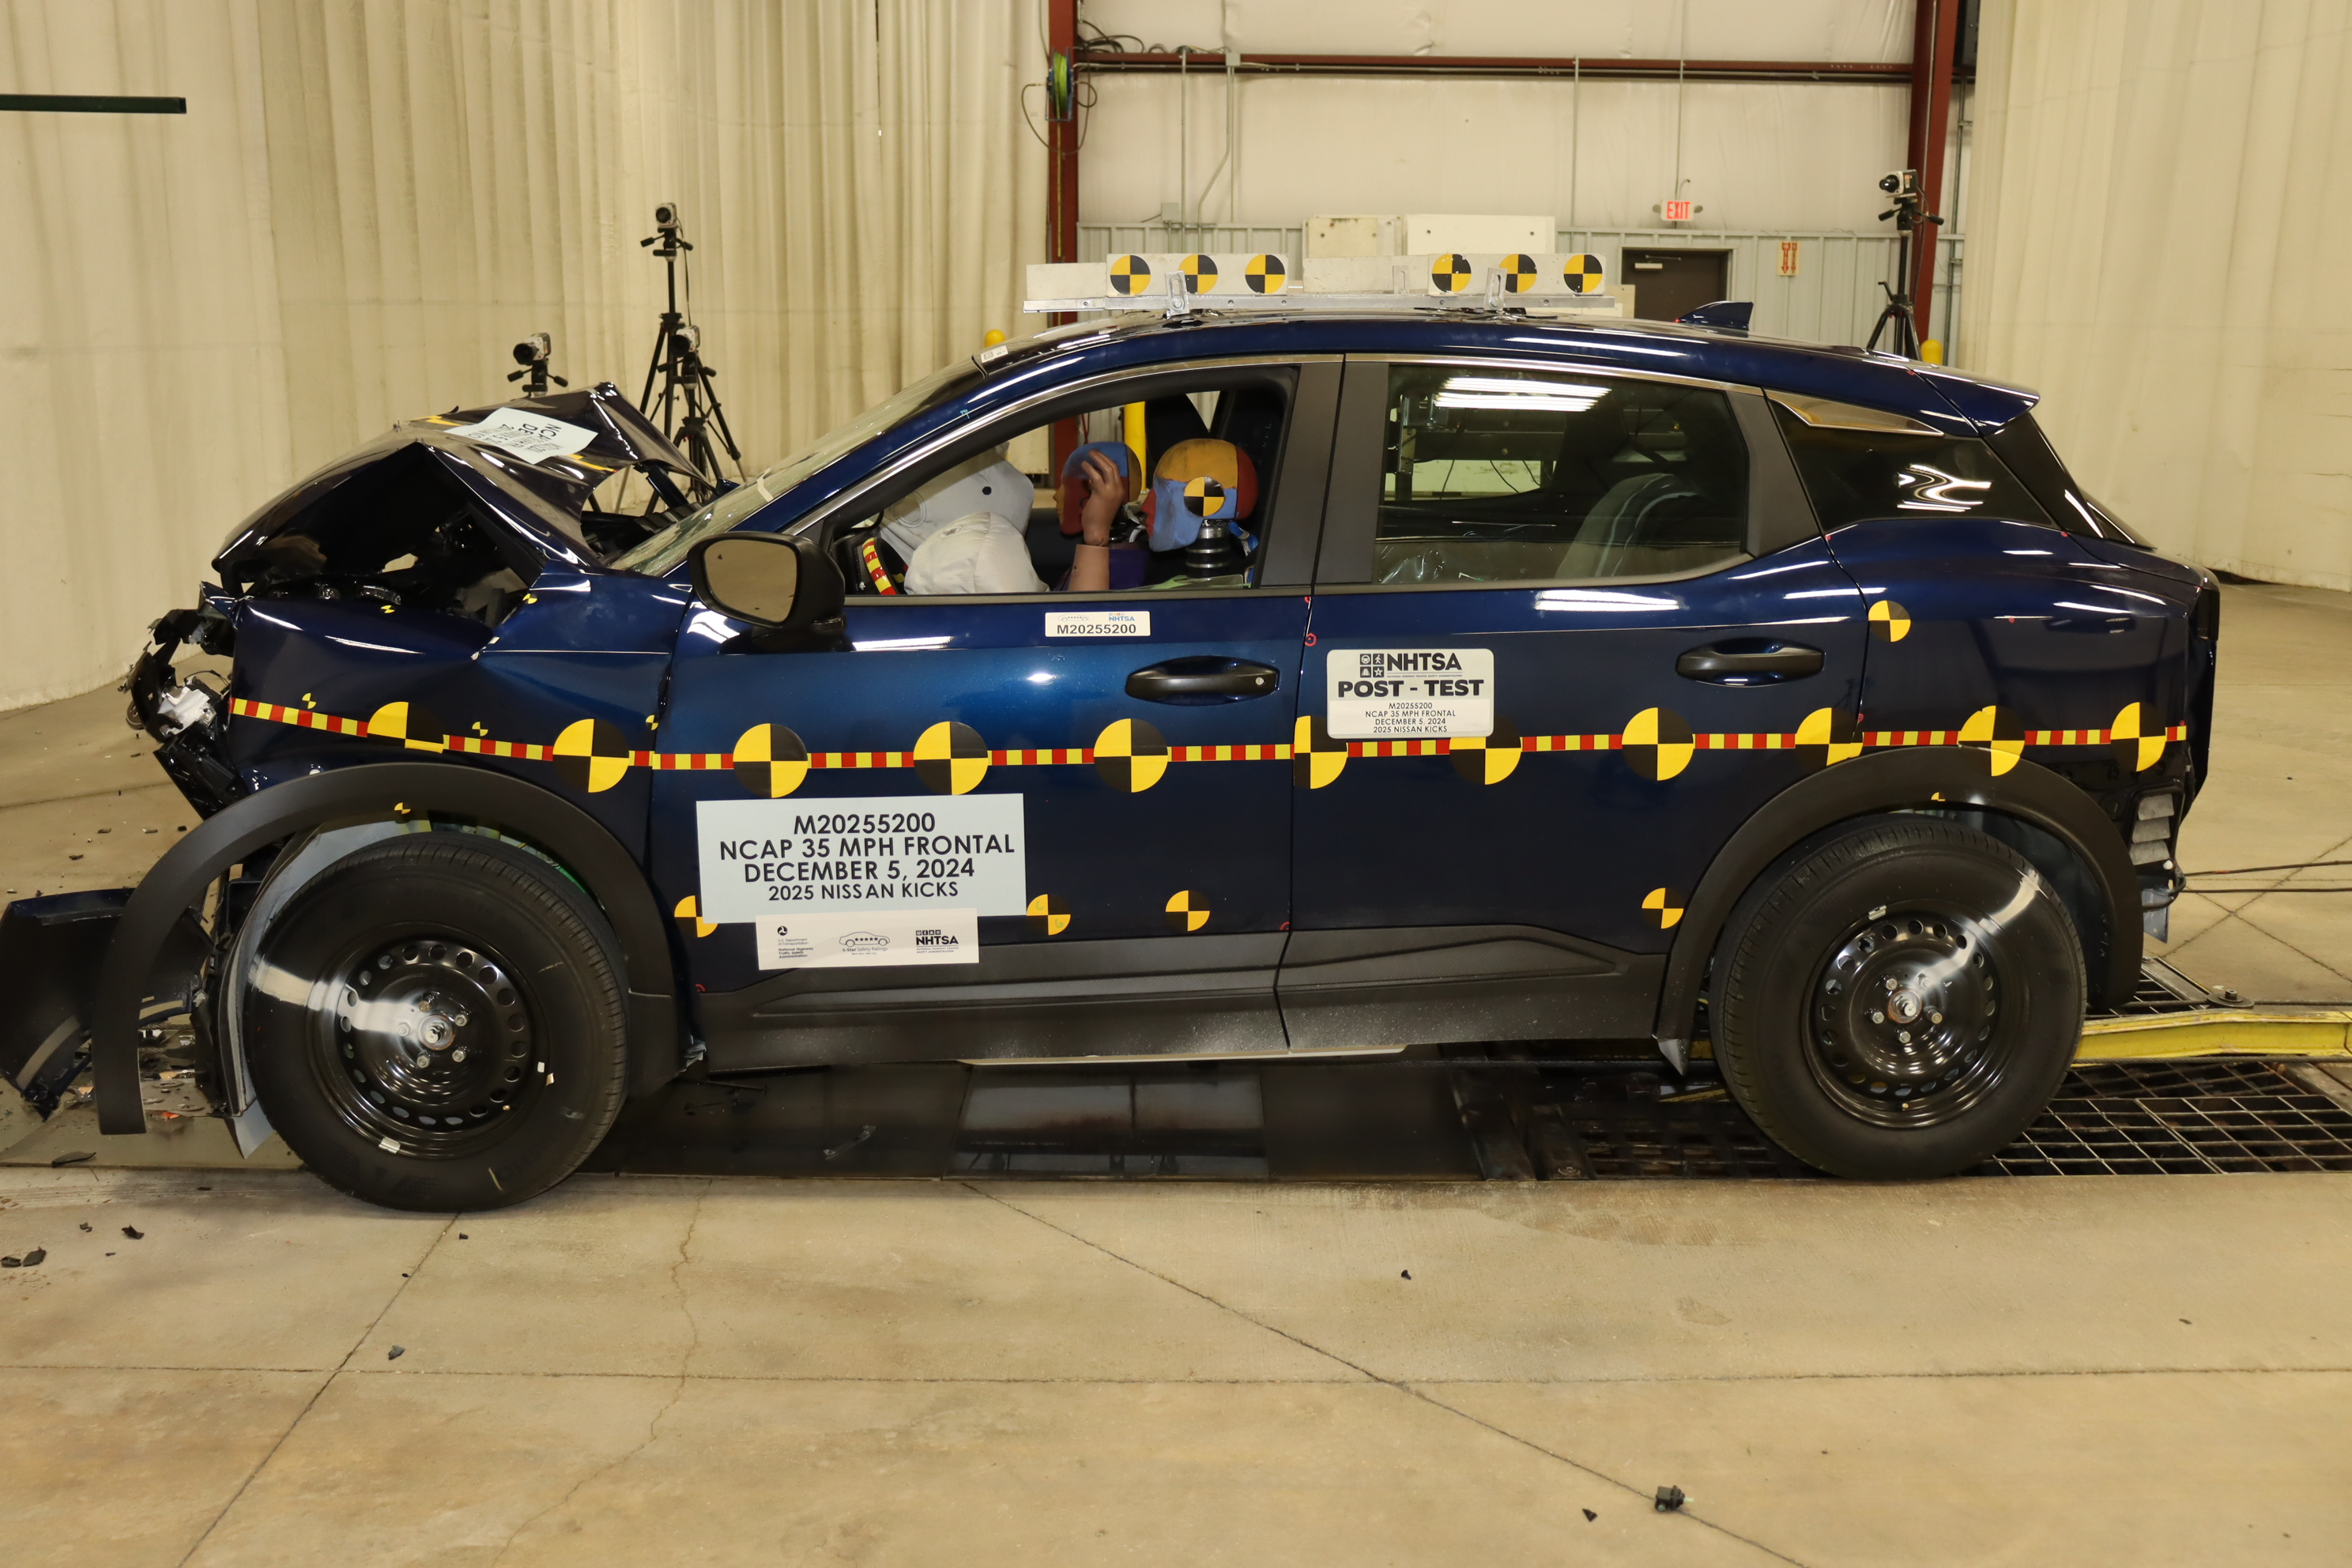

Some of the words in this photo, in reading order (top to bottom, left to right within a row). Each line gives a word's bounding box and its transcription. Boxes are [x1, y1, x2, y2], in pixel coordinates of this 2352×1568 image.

[1667, 201, 1690, 220] EXIT
[1057, 624, 1136, 634] M20255200
[1387, 652, 1462, 671] NHTSA
[1338, 680, 1404, 698] POST
[1424, 679, 1484, 697] TEST
[793, 812, 936, 835] M20255200
[720, 839, 793, 860] NCAP
[801, 838, 831, 858] 35
[839, 836, 895, 857] MPH
[904, 834, 1015, 855] FRONTAL
[744, 859, 879, 883] DECEMBER
[887, 860, 908, 882] 5,
[916, 858, 974, 879] 2024
[768, 884, 814, 901] 2025
[821, 883, 895, 900] NISSAN
[902, 881, 959, 898] KICKS
[916, 935, 959, 945] NHTSA
